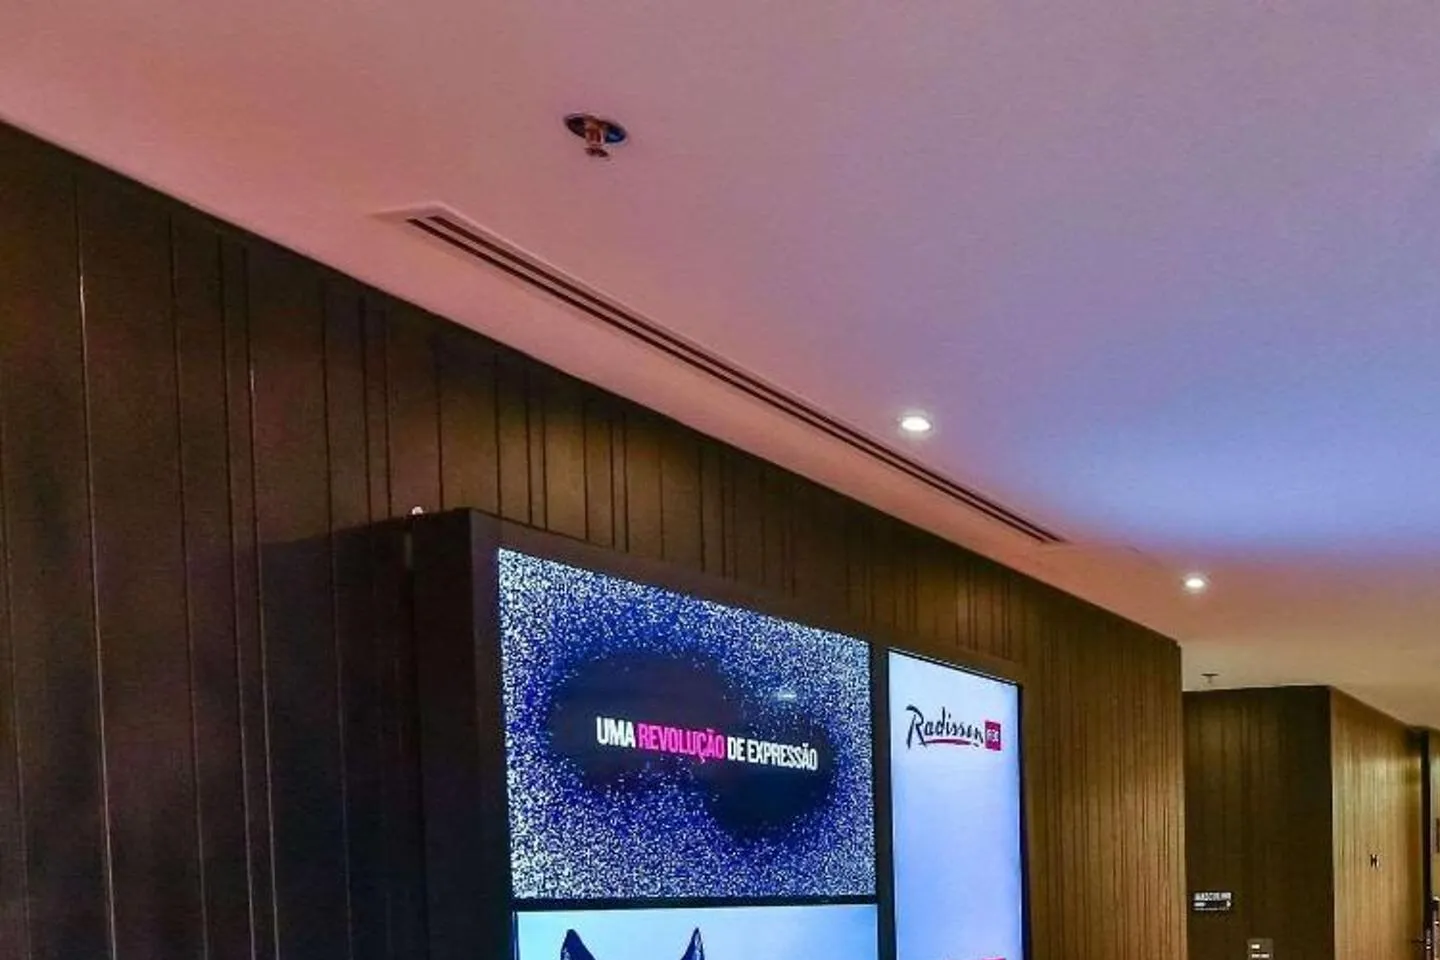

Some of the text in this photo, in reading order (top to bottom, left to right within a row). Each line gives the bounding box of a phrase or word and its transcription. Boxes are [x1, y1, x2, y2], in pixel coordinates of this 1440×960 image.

[596, 716, 819, 771] UMA REVOLUÇÃO DE EXPRESSÃO
[905, 704, 984, 749] Radisson
